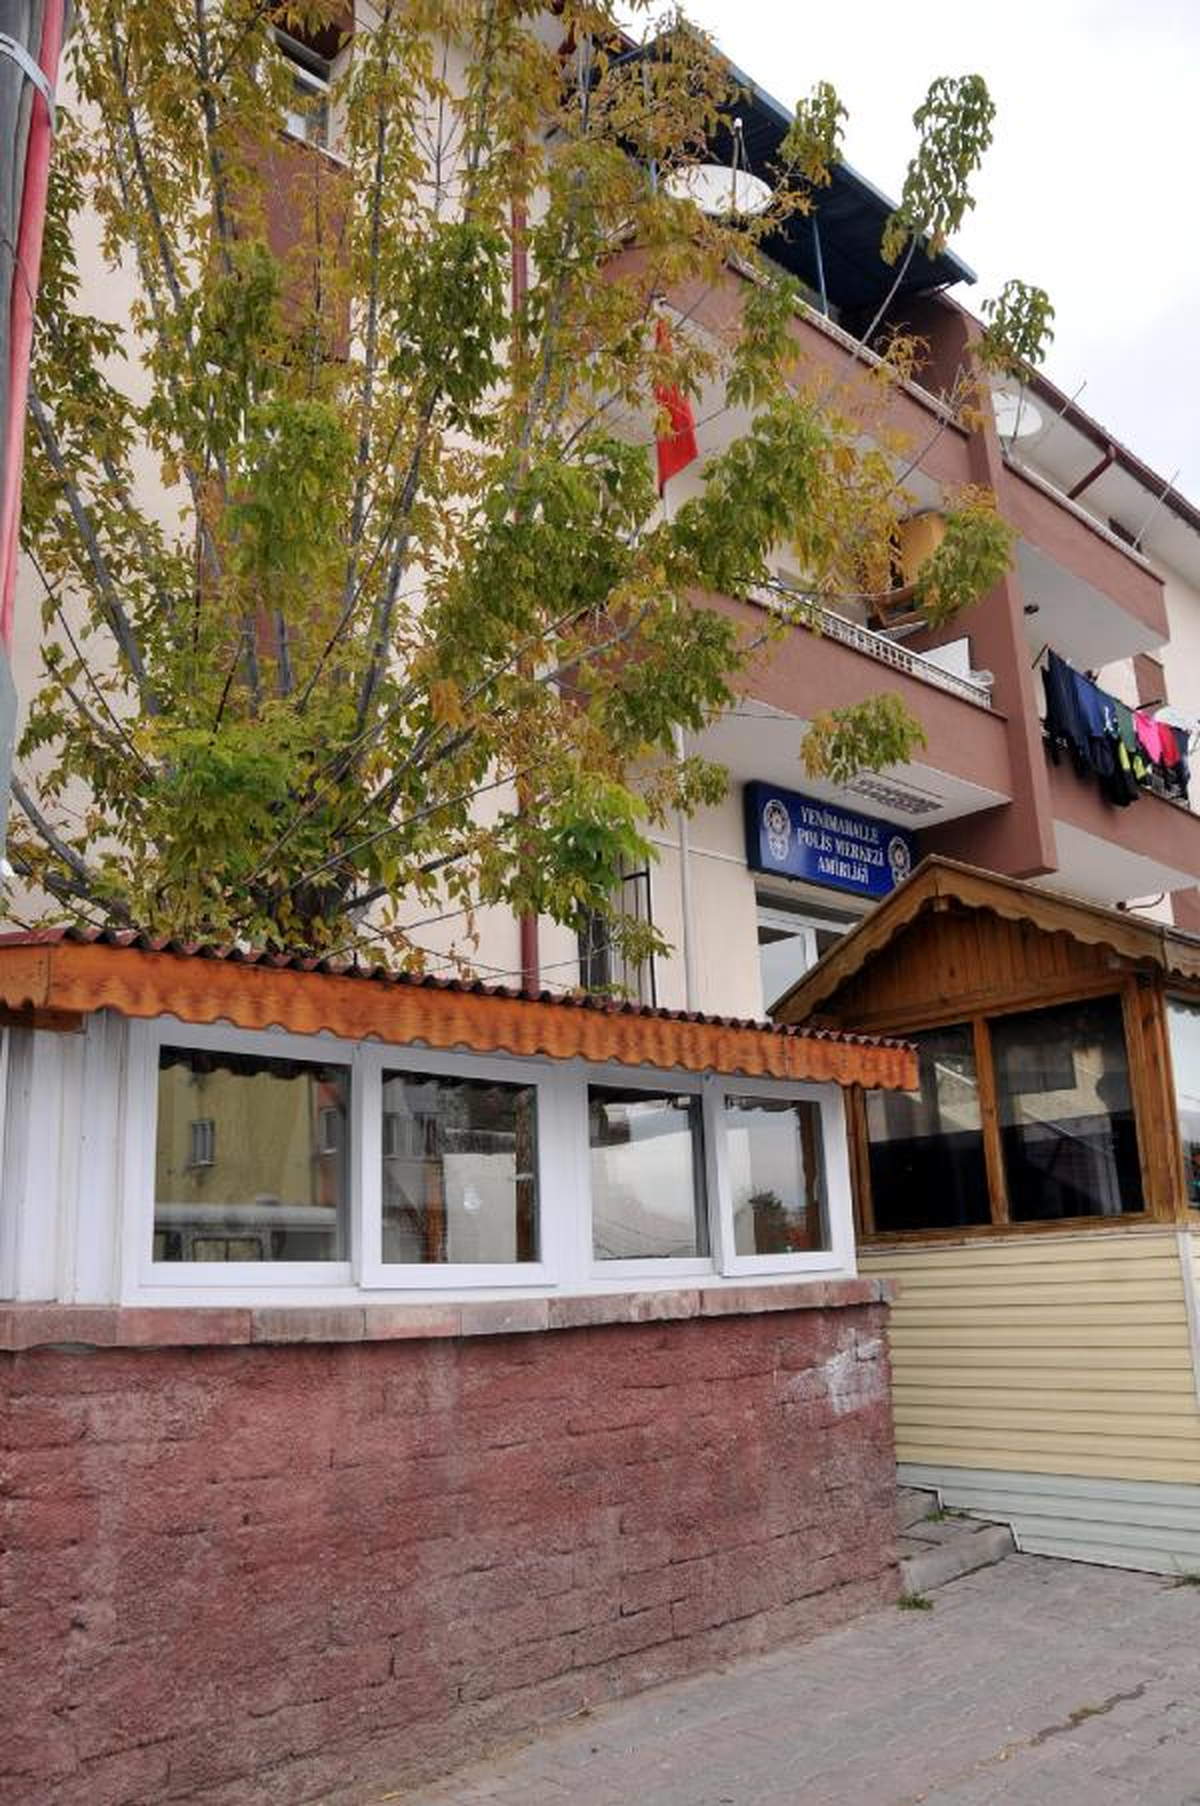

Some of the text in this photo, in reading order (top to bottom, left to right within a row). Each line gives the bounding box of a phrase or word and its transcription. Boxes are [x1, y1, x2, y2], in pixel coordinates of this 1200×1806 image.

[801, 806, 880, 844] YENİMAHALLE
[797, 827, 885, 867] POLİS MERKEZİ
